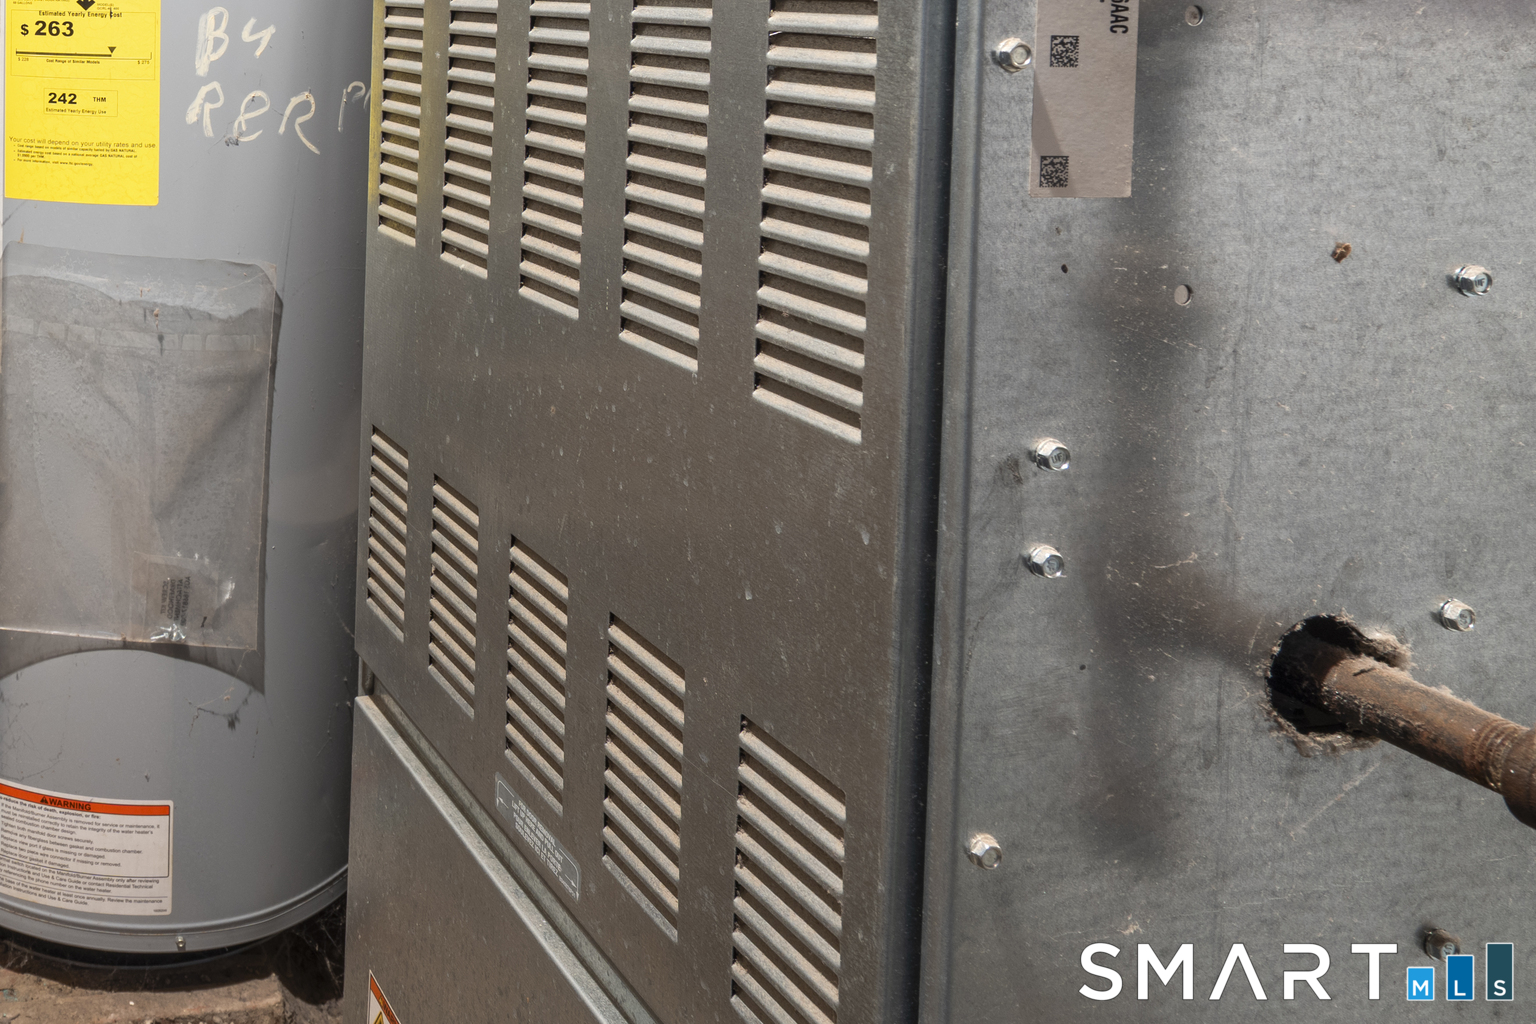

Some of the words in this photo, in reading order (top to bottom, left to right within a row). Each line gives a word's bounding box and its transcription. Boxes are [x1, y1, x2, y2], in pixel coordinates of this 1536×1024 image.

[20, 24, 29, 36] $
[34, 20, 74, 37] 263
[48, 92, 78, 104] 242
[49, 798, 91, 811] WARNING
